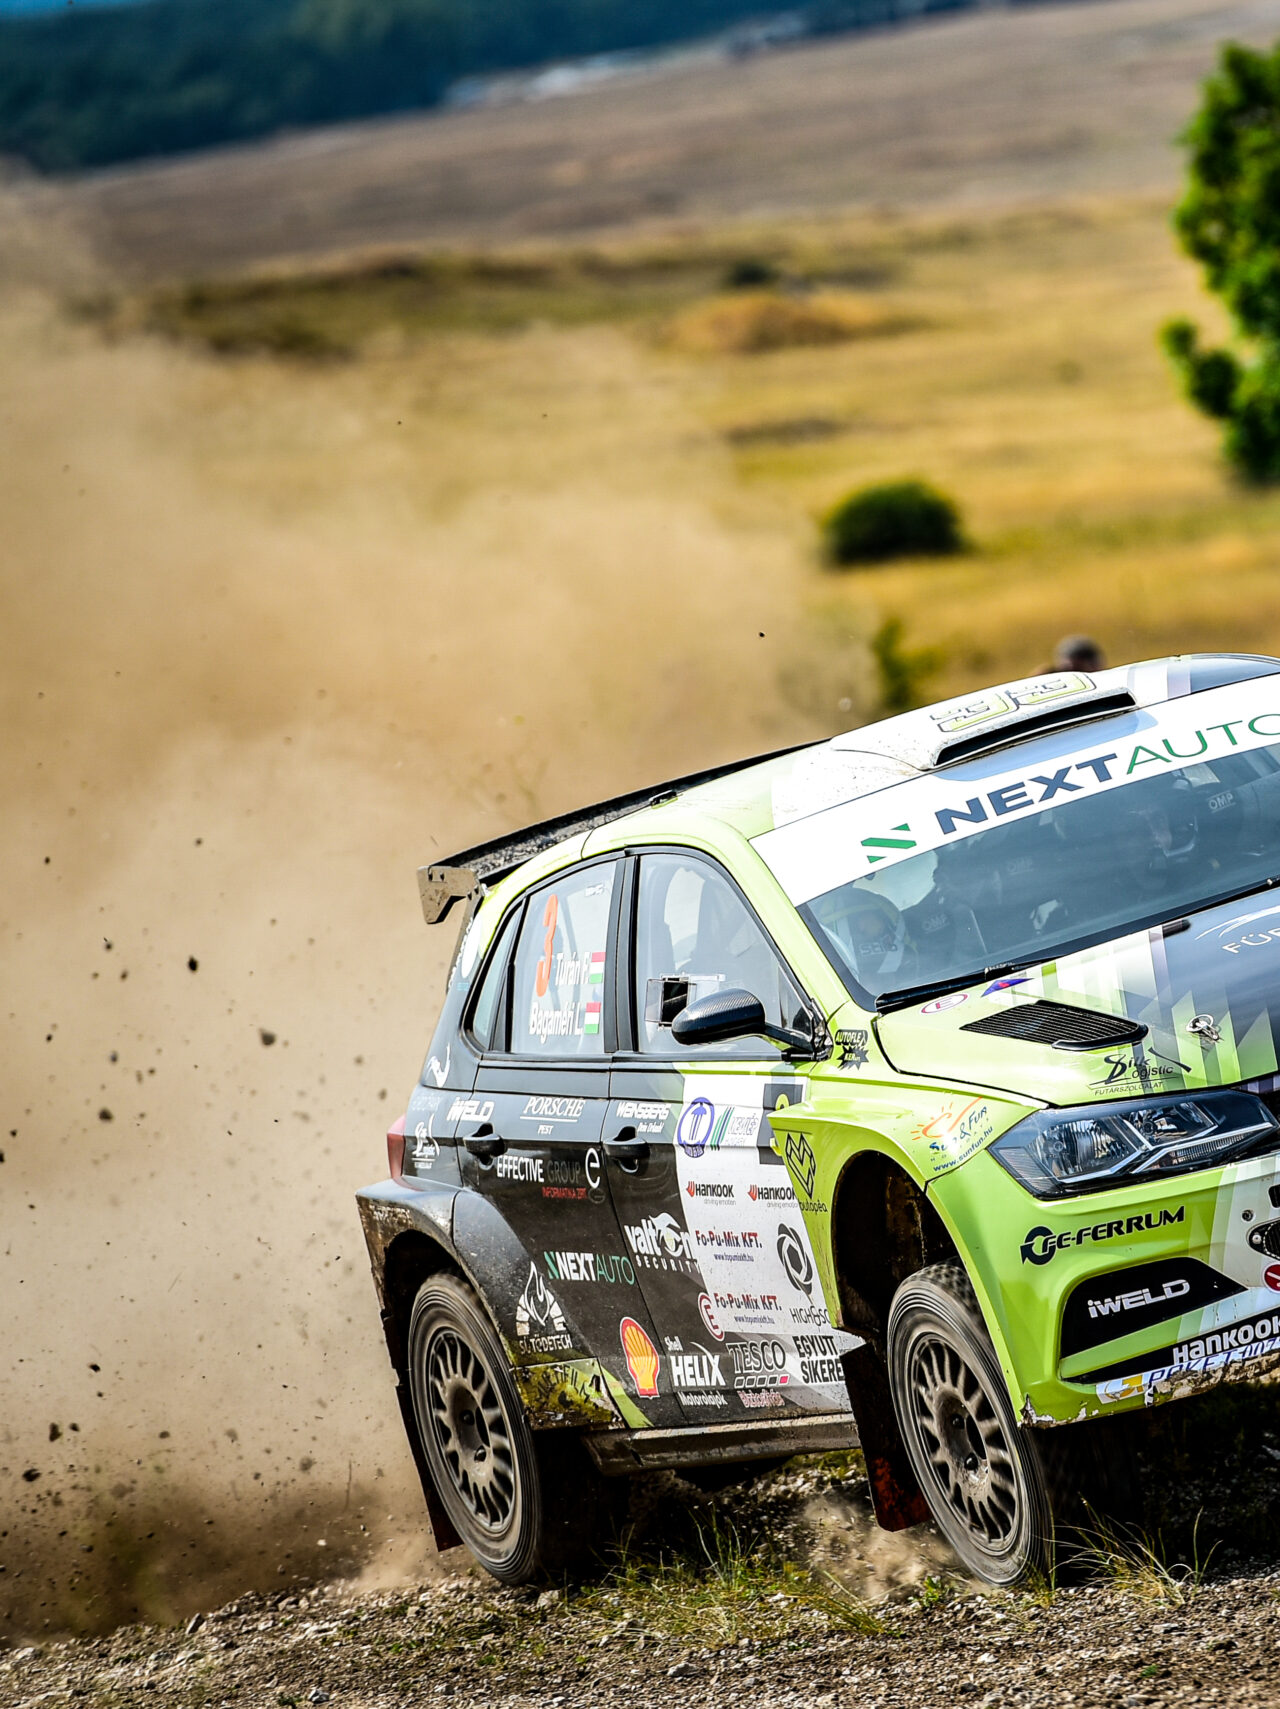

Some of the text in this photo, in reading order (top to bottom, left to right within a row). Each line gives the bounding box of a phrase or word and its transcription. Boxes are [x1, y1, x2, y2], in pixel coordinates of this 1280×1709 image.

[1208, 792, 1234, 811] OMP
[536, 893, 559, 997] 3
[555, 952, 581, 986] Turán
[523, 1096, 586, 1117] PORSCHE
[537, 1124, 553, 1135] PEST
[496, 1156, 545, 1183] EFFECTIVE
[546, 1160, 581, 1184] GROUP
[740, 1231, 763, 1249] KFT.
[557, 1252, 636, 1285] NEXTAUTO
[635, 1255, 701, 1274] SECURITY
[760, 1294, 783, 1311] KFT.
[669, 1346, 727, 1387] HELIX
[726, 1340, 787, 1374] TESCO
